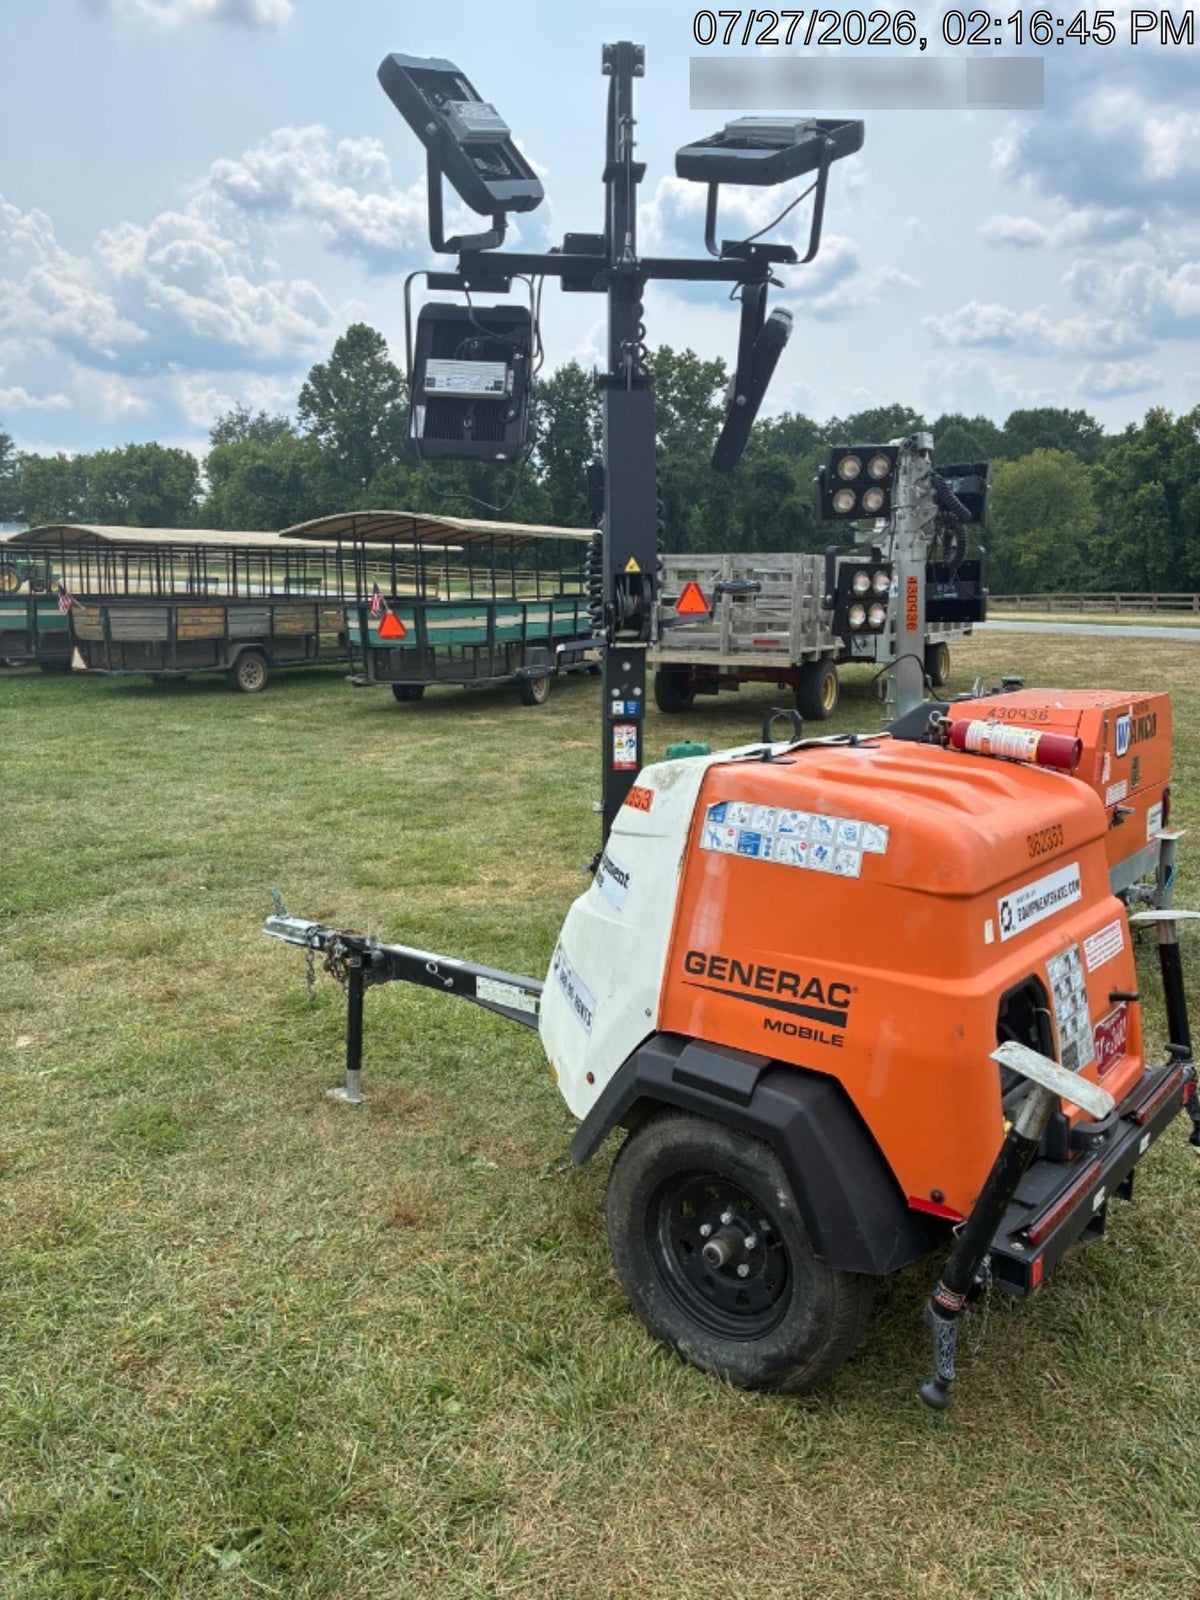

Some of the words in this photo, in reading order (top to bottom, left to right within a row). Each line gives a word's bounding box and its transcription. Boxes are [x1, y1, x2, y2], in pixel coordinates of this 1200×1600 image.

[987, 706, 1049, 721] 430936
[684, 950, 851, 1009] GENERAC
[763, 1018, 845, 1048] MOBILE
